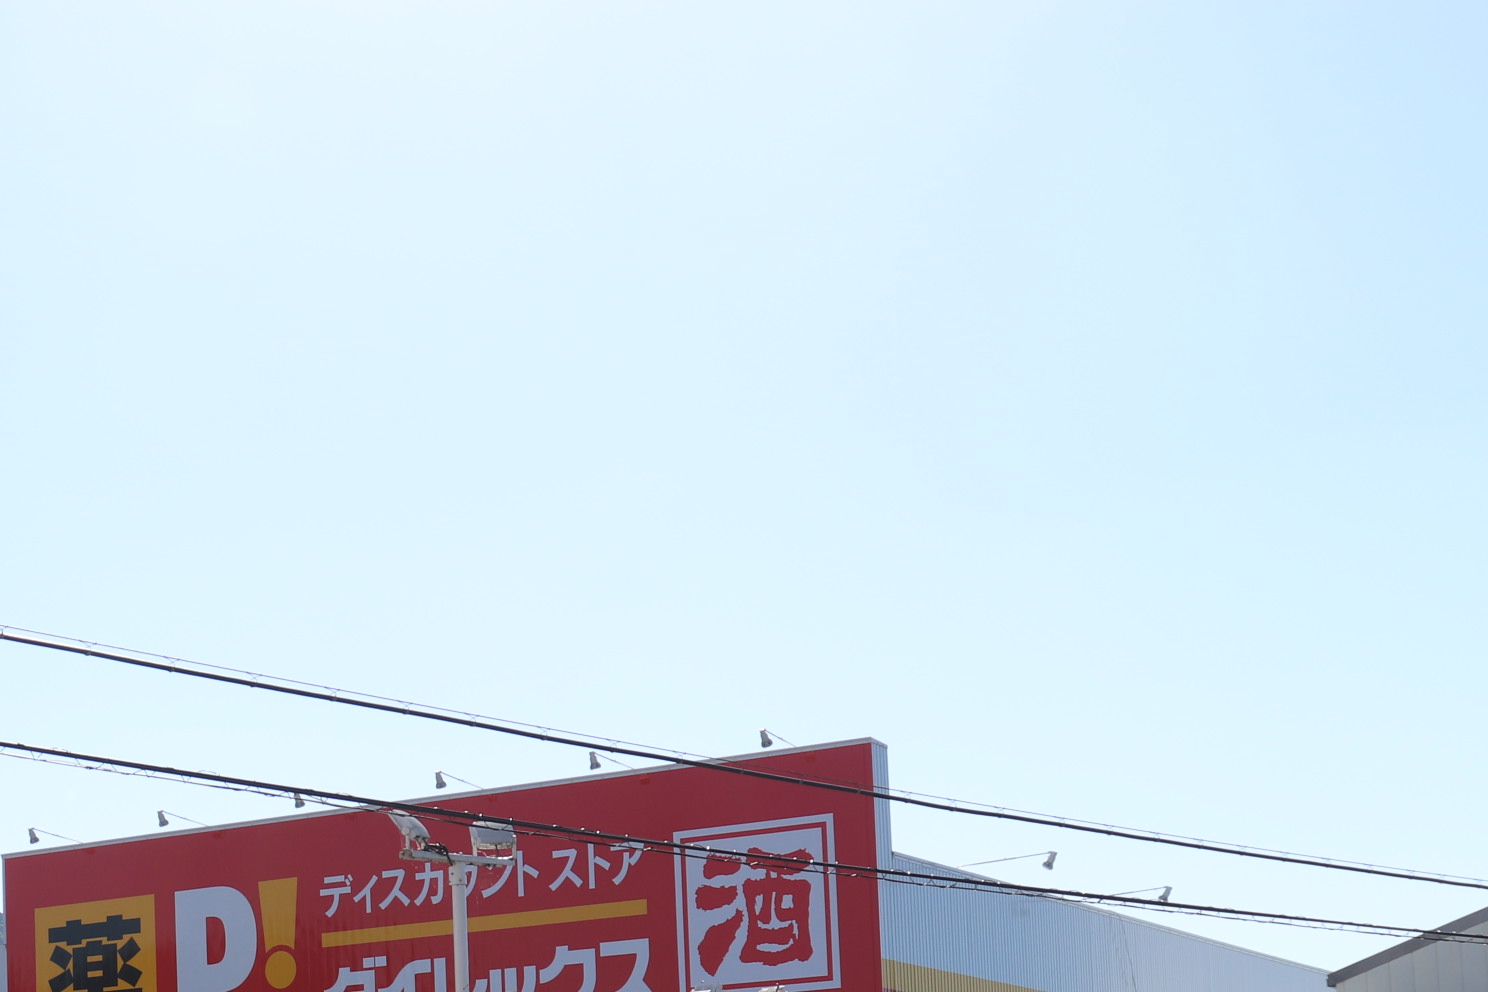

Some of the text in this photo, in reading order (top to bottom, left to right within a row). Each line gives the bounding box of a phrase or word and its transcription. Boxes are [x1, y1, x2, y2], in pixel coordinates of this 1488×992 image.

[549, 842, 645, 892] ストア
[695, 847, 814, 977] 酒
